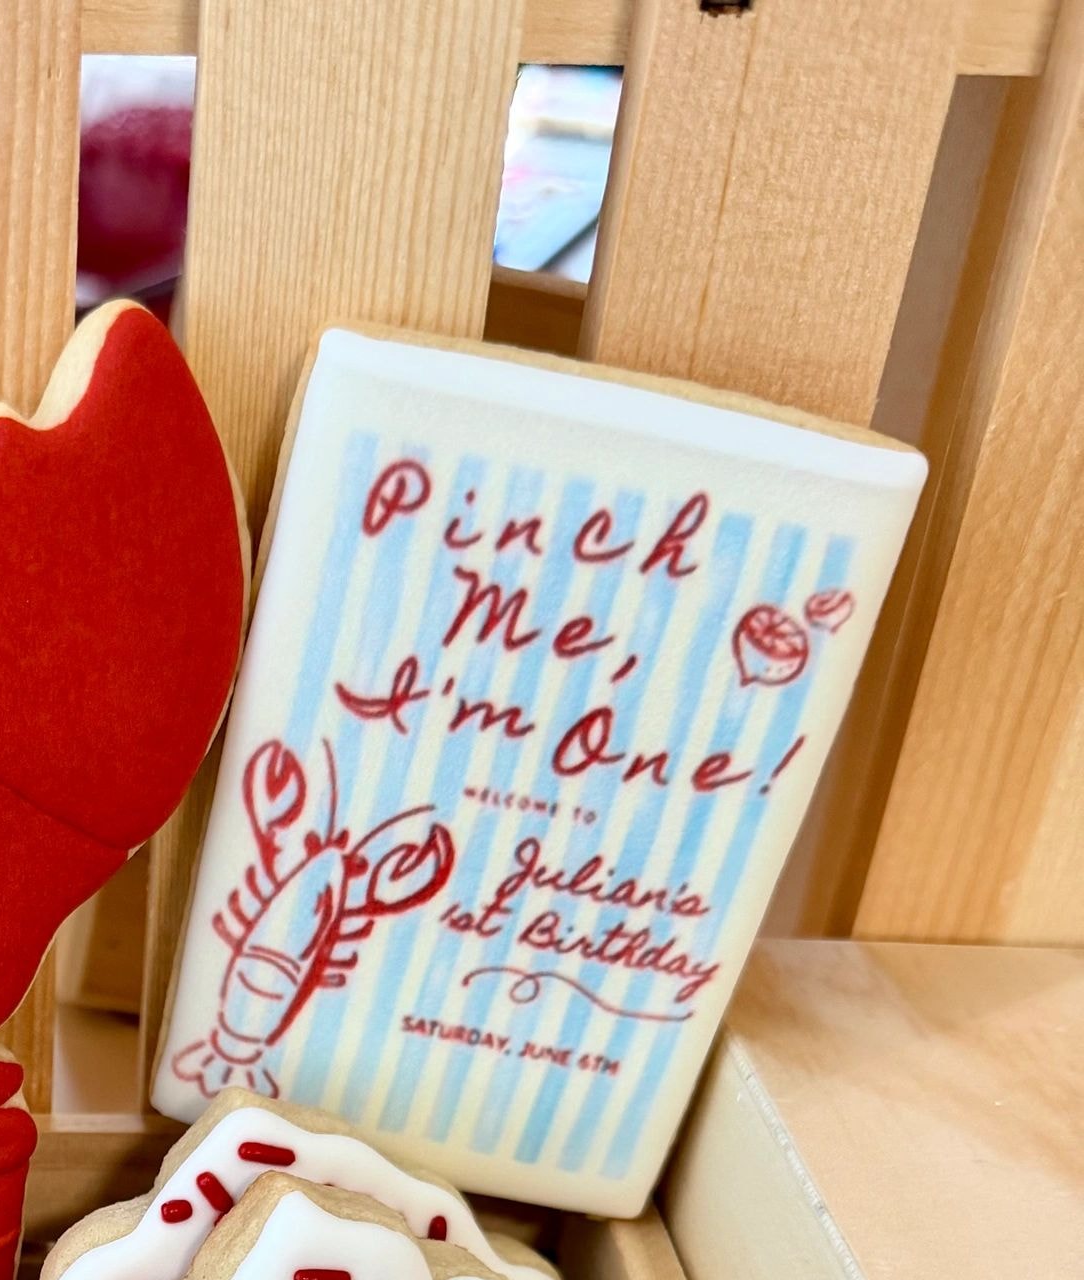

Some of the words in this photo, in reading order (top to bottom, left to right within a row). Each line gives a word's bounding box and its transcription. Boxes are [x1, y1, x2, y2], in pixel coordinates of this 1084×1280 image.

[361, 460, 710, 579] Pinch
[442, 566, 639, 684] Me,
[334, 655, 536, 735] I'm
[551, 705, 807, 796] One!
[463, 785, 559, 818] WELCOME
[573, 805, 598, 826] TO
[494, 836, 711, 917] Julian's
[518, 910, 721, 1004] Birthday
[401, 1015, 512, 1057] SATURDAY,
[518, 1041, 572, 1068] JUNE
[576, 1053, 622, 1077] 6TH
